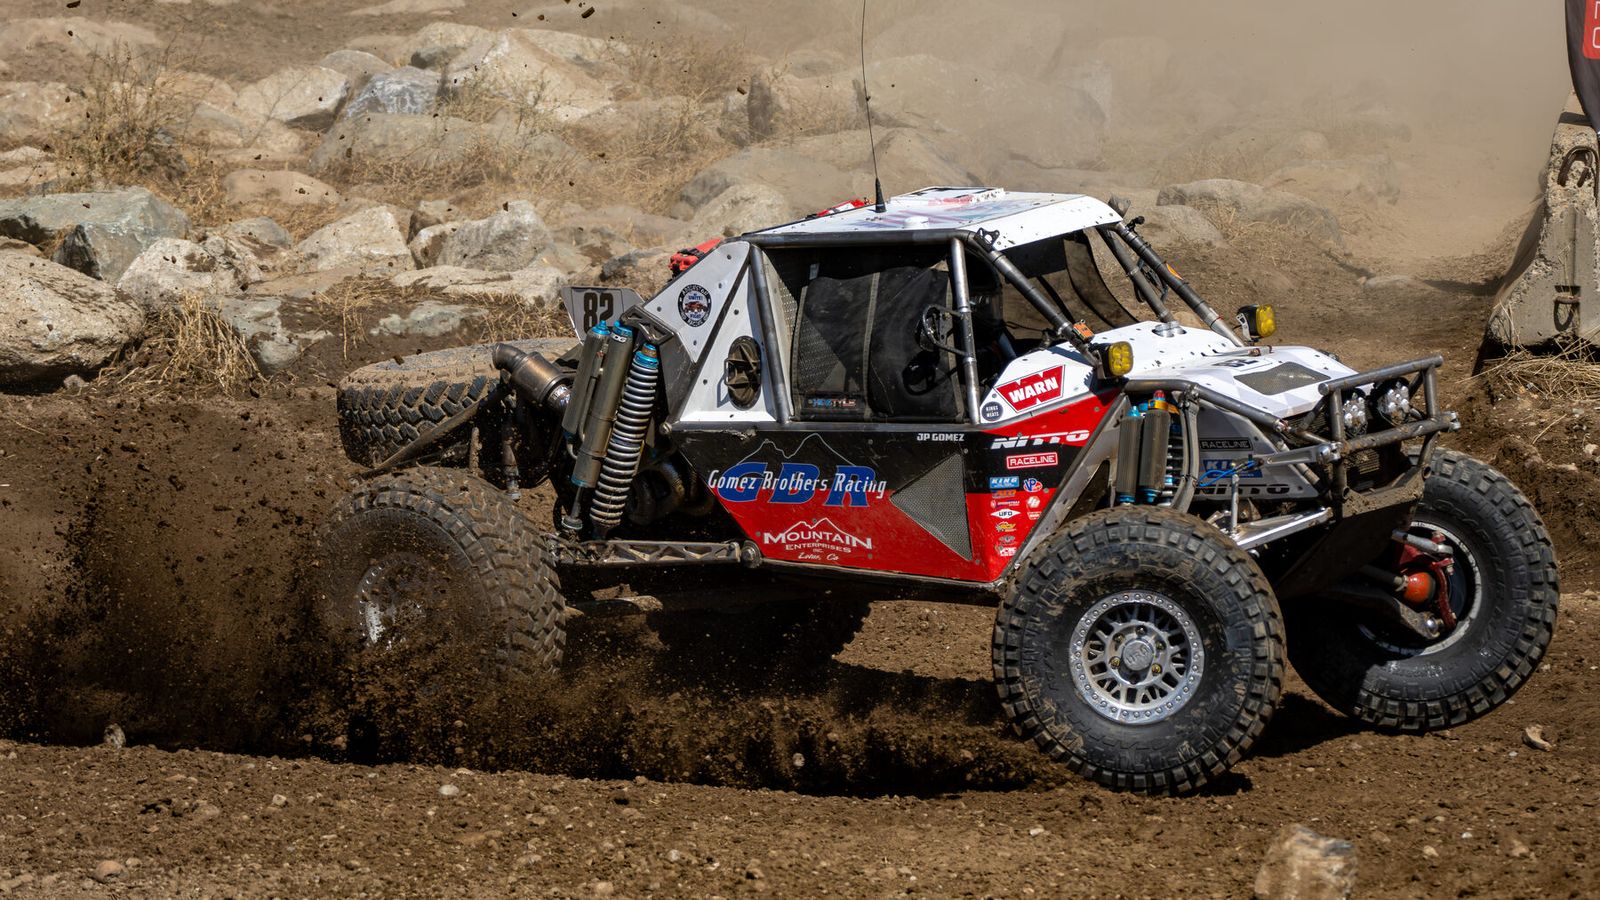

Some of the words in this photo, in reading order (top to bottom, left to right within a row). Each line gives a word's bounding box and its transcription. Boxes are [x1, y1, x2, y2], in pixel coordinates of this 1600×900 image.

[583, 292, 613, 334] 82
[1008, 376, 1059, 403] WARN
[916, 432, 930, 442] JP
[931, 432, 965, 442] GOMEZ
[990, 429, 1090, 450] NITTO
[1201, 440, 1250, 449] RACELINE
[1010, 455, 1055, 466] RACELINE
[708, 469, 757, 489] Gomez
[762, 471, 828, 492] Brothers
[834, 473, 888, 499] Racing
[717, 461, 876, 507] GBR
[763, 530, 873, 550] MOUNTAIN
[785, 542, 852, 553] ENTERPRISES
